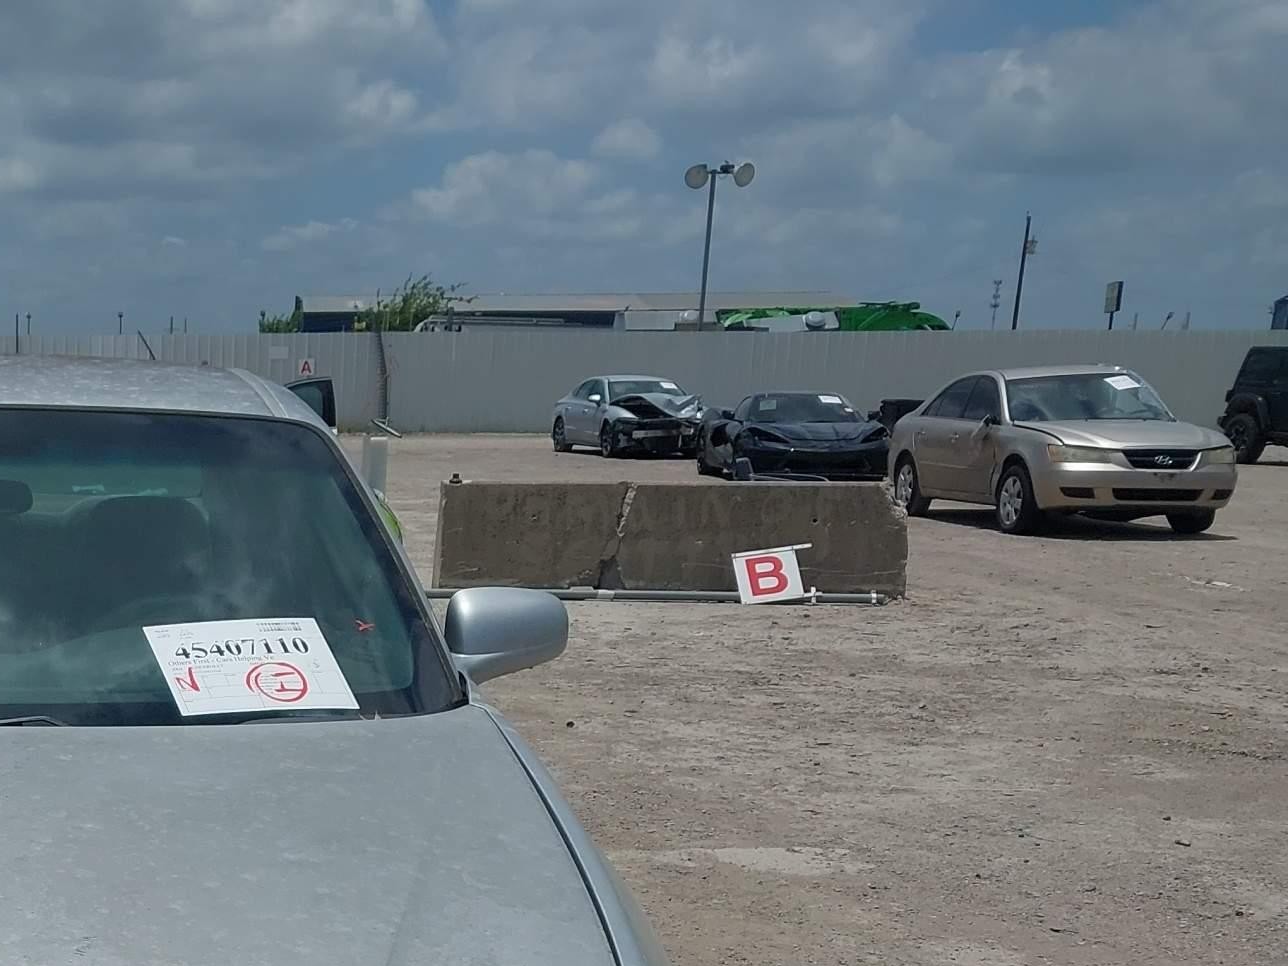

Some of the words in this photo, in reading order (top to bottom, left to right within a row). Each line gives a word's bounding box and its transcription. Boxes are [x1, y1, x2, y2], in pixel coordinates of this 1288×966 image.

[301, 360, 312, 374] A
[745, 556, 789, 597] B
[175, 637, 309, 659] 45407110
